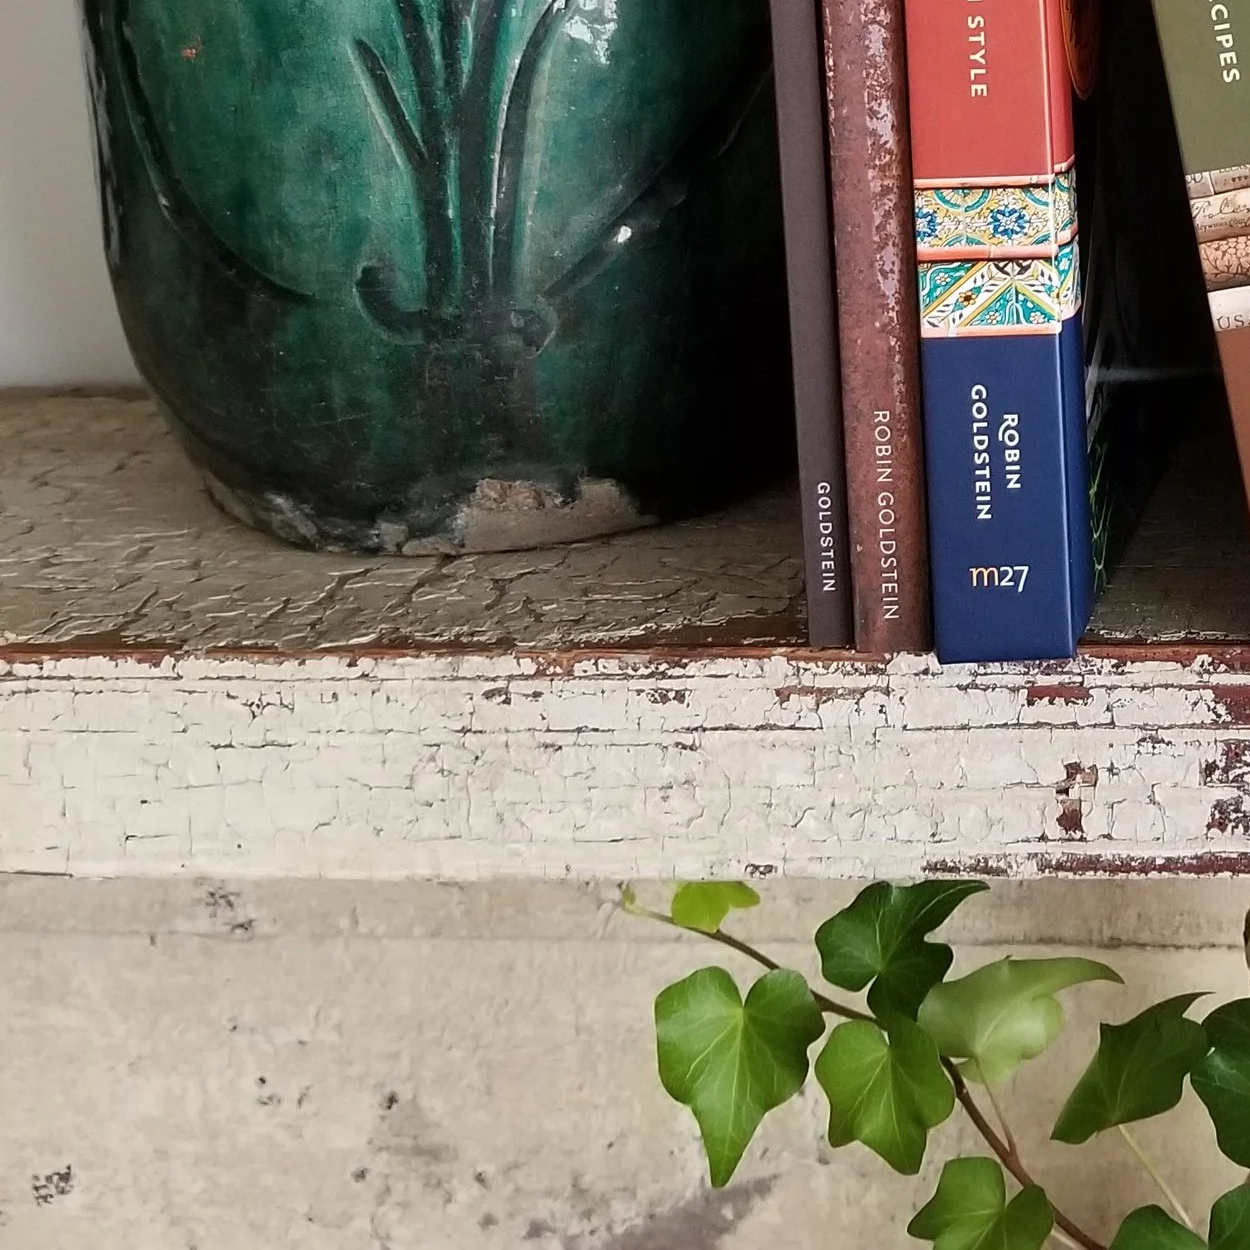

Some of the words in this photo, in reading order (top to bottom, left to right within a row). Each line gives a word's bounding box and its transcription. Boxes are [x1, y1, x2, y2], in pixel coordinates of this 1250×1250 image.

[967, 15, 988, 98] STYLE
[873, 409, 894, 483] ROBIN
[970, 383, 992, 519] GOLDSTEIN
[998, 413, 1021, 489] ROBIN
[816, 482, 836, 592] GOLDSTEIN
[877, 492, 900, 620] GOLDSTEIN
[969, 565, 1030, 593] m27
